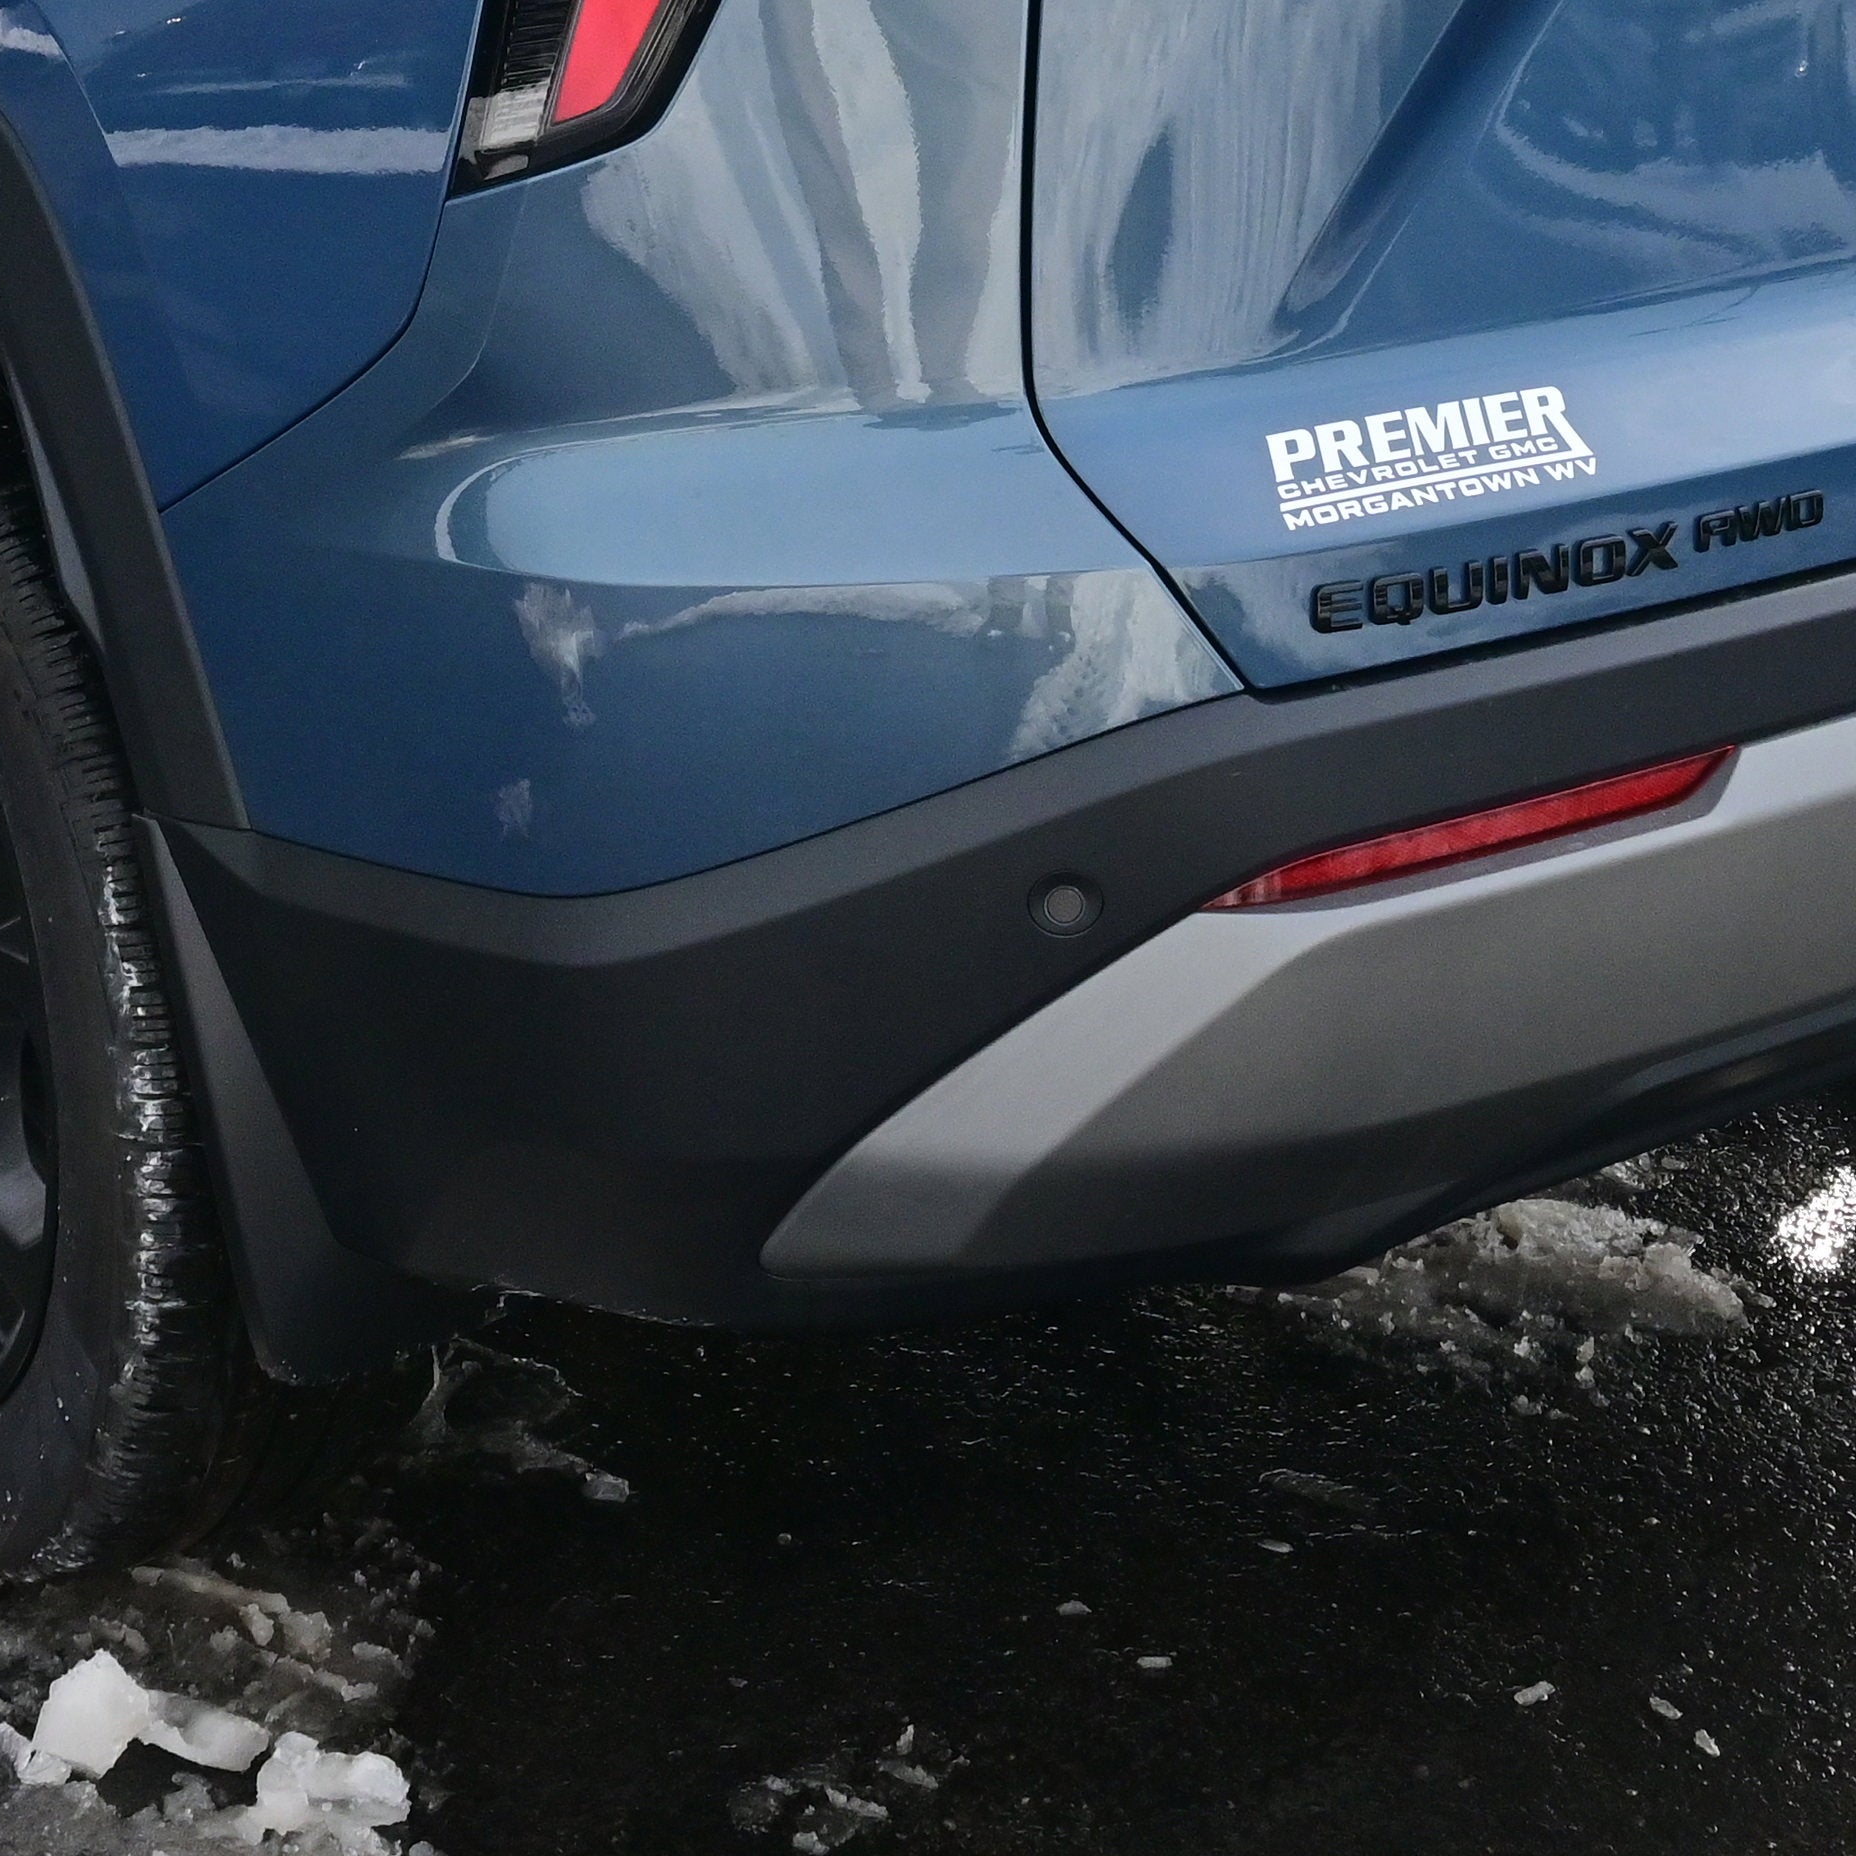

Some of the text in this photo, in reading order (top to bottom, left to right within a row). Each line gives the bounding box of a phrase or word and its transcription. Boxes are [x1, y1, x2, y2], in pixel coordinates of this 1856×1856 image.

[1265, 385, 1592, 482] PREMIER
[1277, 436, 1559, 500] CHEVROLET GMC
[1282, 458, 1598, 531] MORGANTOWN WV
[1309, 488, 1824, 634] EQUINOX AWD
